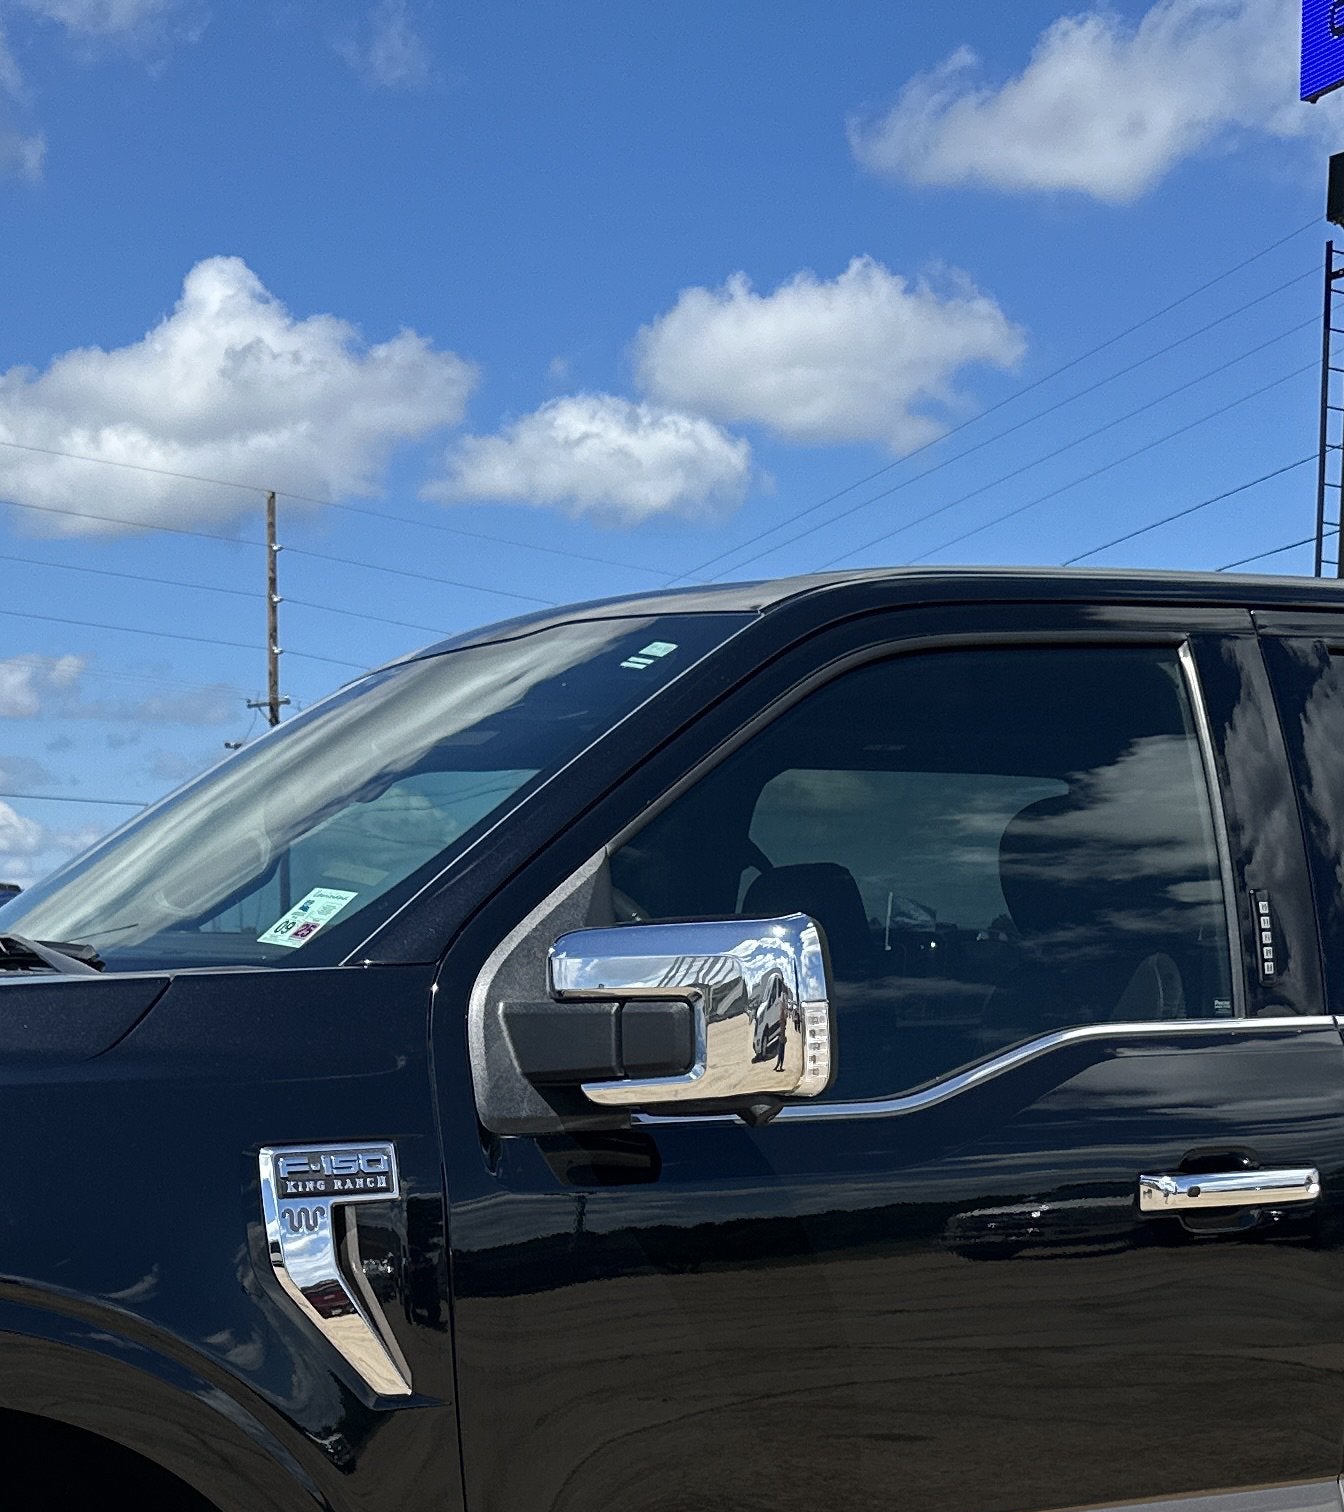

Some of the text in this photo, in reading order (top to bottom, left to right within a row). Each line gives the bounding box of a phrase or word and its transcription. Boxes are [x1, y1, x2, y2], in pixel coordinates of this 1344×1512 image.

[273, 919, 297, 935] 09
[278, 1153, 389, 1178] F-150
[286, 1175, 387, 1193] KING RANCH
